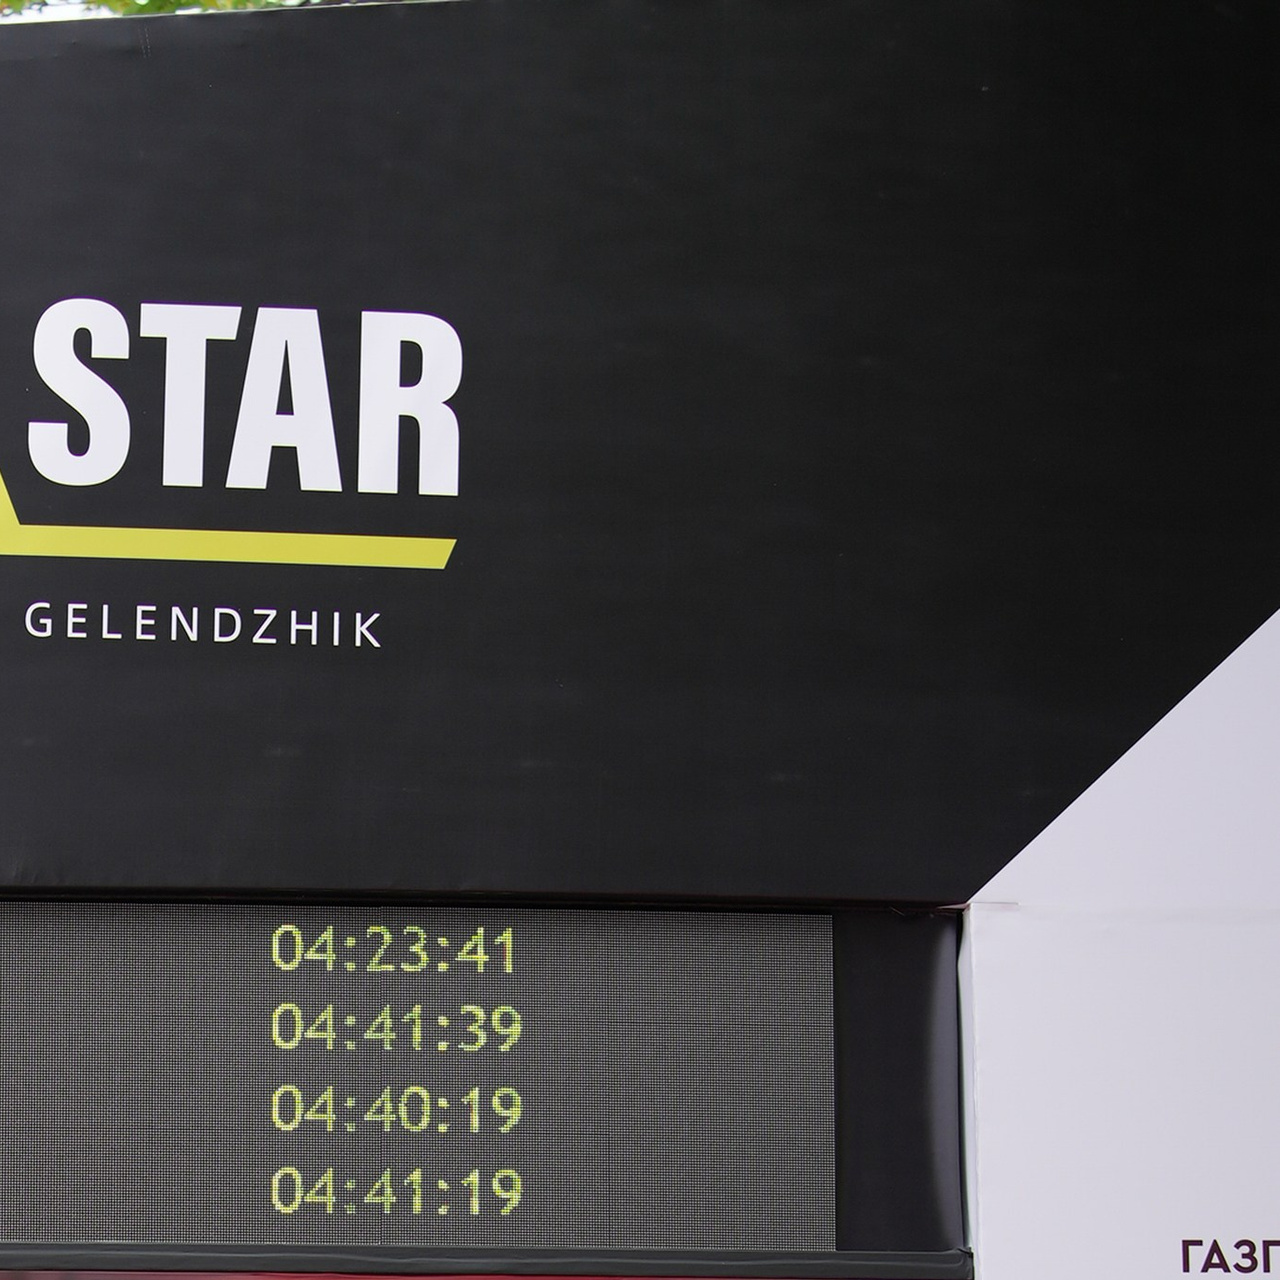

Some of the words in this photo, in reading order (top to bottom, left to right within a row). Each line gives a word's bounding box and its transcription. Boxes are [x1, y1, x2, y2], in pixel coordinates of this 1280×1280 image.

[27, 298, 463, 497] STAR
[24, 601, 384, 648] GELENDZHIK
[271, 924, 515, 973] 04:23:41
[271, 1003, 522, 1051] 04:41:39
[271, 1084, 522, 1133] 04:40:19
[271, 1166, 522, 1215] 04:41:19
